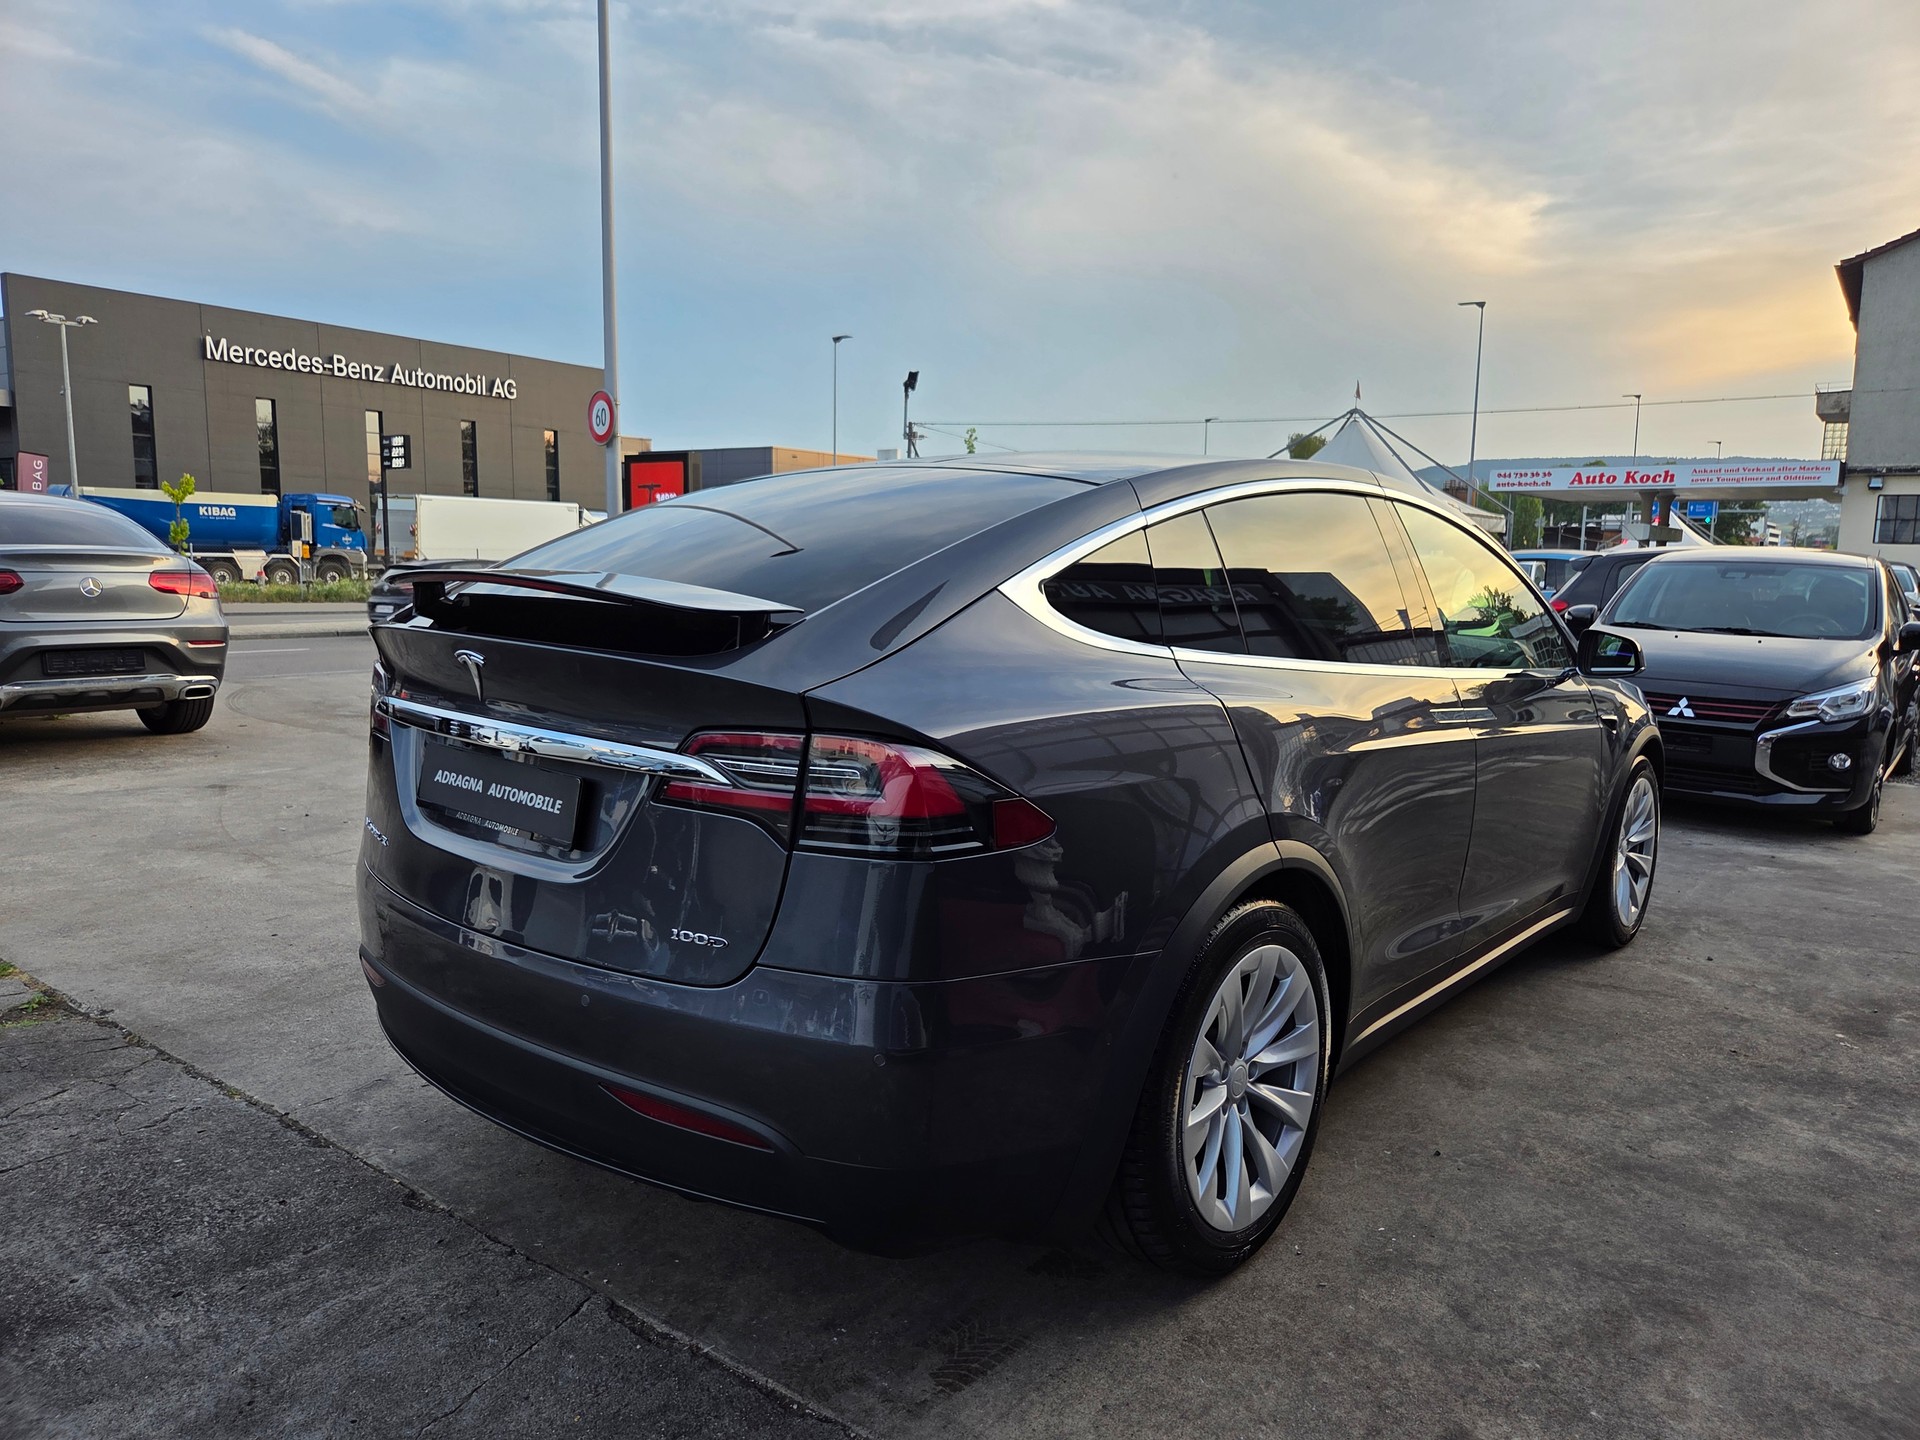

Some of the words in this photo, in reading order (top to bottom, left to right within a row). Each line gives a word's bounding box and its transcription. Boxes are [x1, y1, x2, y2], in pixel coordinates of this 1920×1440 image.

[205, 335, 385, 383] Mercedes-Benz
[390, 362, 486, 396] Automobil
[492, 376, 517, 400] AG
[595, 407, 607, 427] 60
[1496, 480, 1552, 488] auto-koch.ch
[1568, 472, 1618, 486] Auto
[1623, 469, 1676, 485] Koch
[199, 506, 237, 517] KIBAG
[434, 769, 484, 794] ADRAGNA
[487, 782, 563, 815] AUTOMOBILE
[670, 928, 729, 948] 100D
